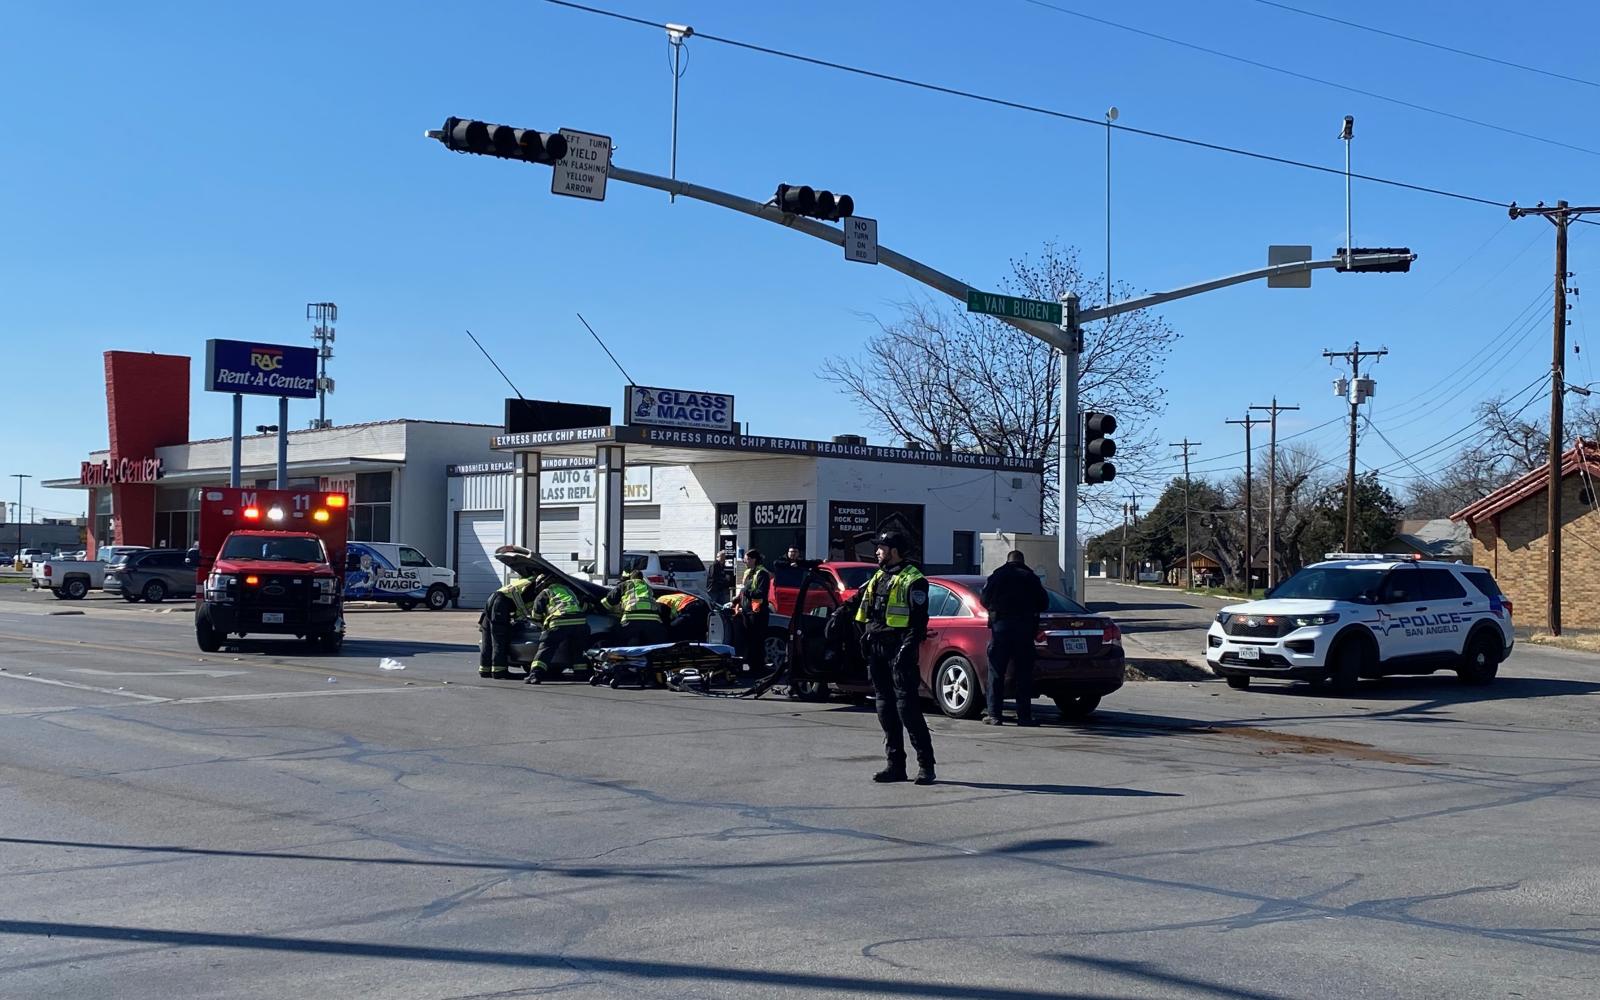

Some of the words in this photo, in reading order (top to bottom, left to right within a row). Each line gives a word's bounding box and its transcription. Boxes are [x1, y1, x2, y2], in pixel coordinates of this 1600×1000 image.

[565, 134, 580, 144] EFT
[589, 138, 608, 149] TURN
[570, 146, 598, 161] YIELD
[557, 159, 568, 168] ON
[571, 160, 606, 174] FLASHING
[566, 171, 595, 183] YELLOW
[565, 182, 593, 194] ARROW
[854, 221, 867, 231] NO
[854, 231, 869, 240] TURN
[856, 241, 866, 249] ON
[855, 250, 867, 259] RED
[984, 295, 1006, 314] VAN
[1013, 300, 1049, 320] BUREN
[250, 353, 283, 371] RAC
[657, 391, 727, 410] GLASS
[657, 405, 726, 423] MAGIC
[496, 434, 530, 446] EXPRESS
[532, 432, 553, 443] ROCK
[555, 430, 574, 441] CHIP
[577, 428, 606, 439] REPAIR
[650, 430, 701, 443] EXPRESS
[706, 434, 736, 446] ROCK
[740, 436, 766, 448] CHIP
[770, 438, 808, 450] REPAIR
[817, 441, 873, 456] HEADLIGHT
[876, 448, 942, 461] RESTORATION
[951, 453, 976, 464] ROCK
[979, 455, 1000, 465] CHIP
[1003, 457, 1034, 468] REPAIR
[490, 461, 514, 471] REPLAC
[541, 458, 567, 468] WINDOW
[569, 457, 596, 466] POLISHI
[552, 470, 580, 484] AUTO
[583, 470, 591, 483] &
[541, 487, 565, 500] LASS
[241, 492, 257, 507] M
[293, 494, 310, 510] 11
[754, 504, 804, 524] 655-2727
[838, 507, 866, 515] EXPRESS
[383, 571, 417, 579] GLASS
[379, 580, 420, 590] MAGIC
[1400, 612, 1461, 628] POLICE
[1405, 628, 1424, 637] SAN
[1426, 625, 1459, 636] ANGELO
